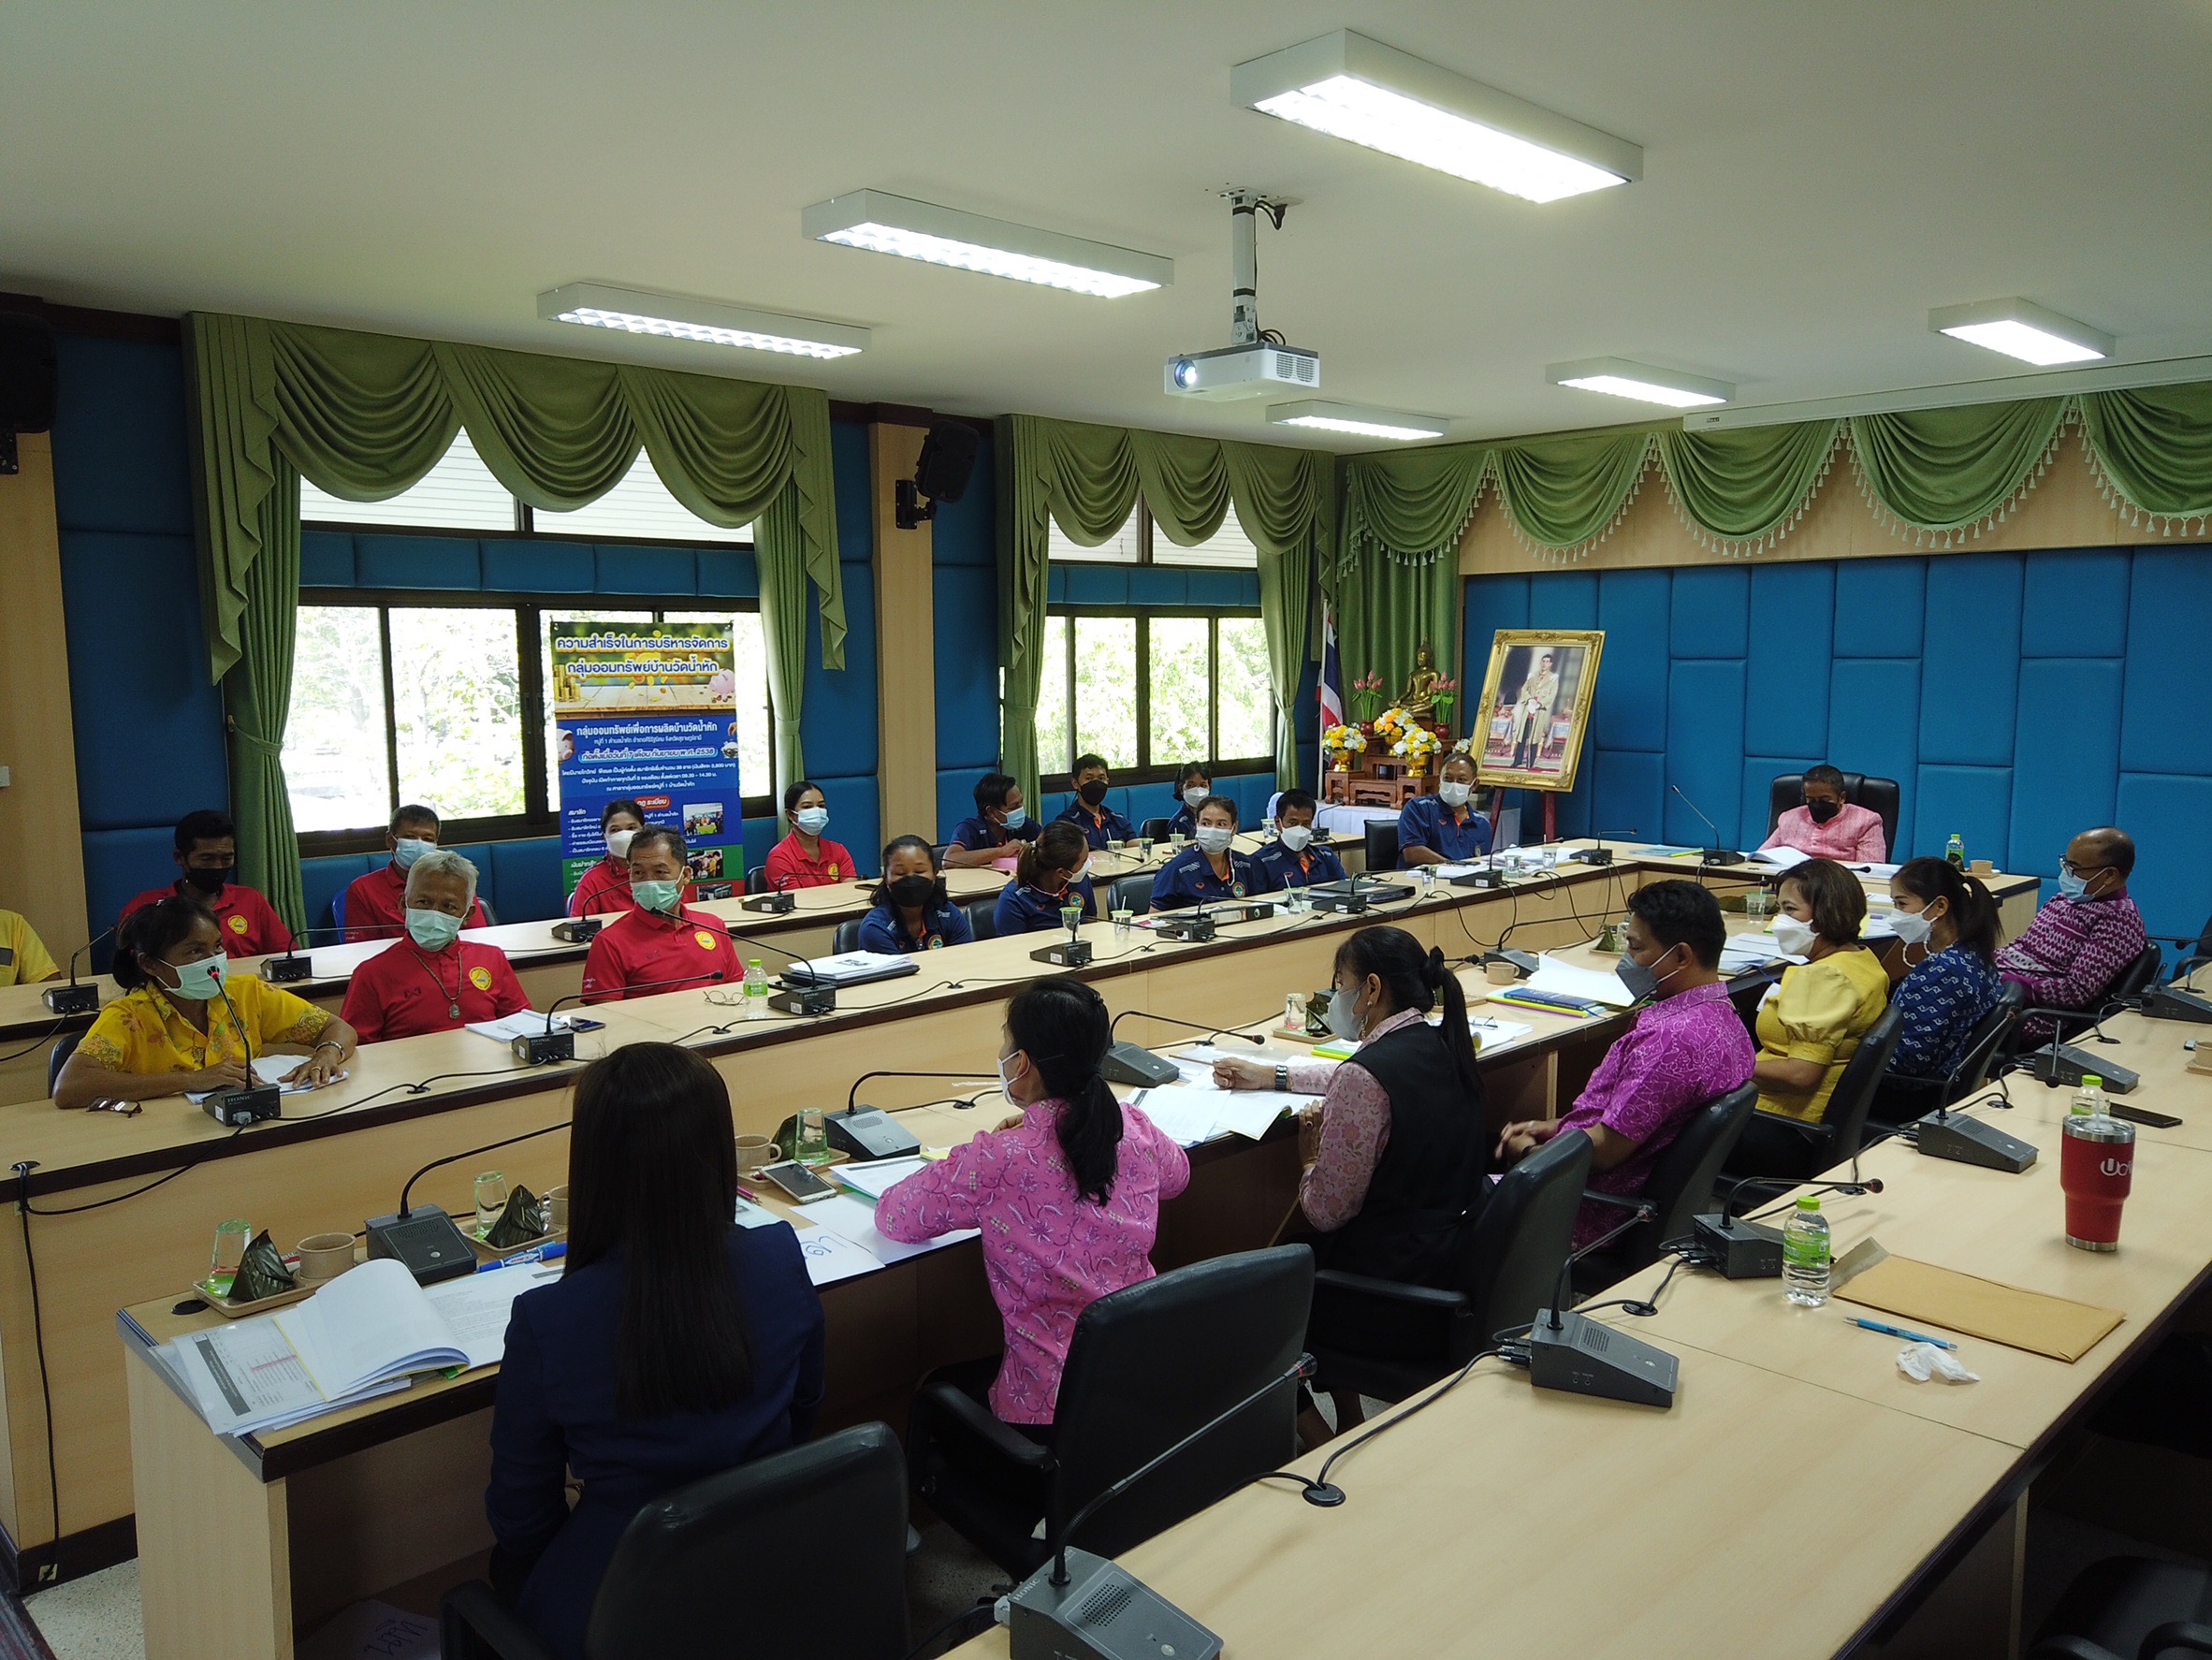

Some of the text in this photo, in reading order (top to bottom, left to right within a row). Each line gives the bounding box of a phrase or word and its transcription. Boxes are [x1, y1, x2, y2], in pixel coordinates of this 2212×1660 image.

[557, 634, 728, 648] ความสำเร็จในการบริหารจัดการ
[567, 656, 719, 677] กลุ่มออมทรัพย์บ้านวัดน้ำหัก
[576, 720, 718, 738] กลุ่มออมทรัพย์เพื่อการผลิตบ้านวัดน้ำหัก
[1013, 1578, 1041, 1601] HONIC
